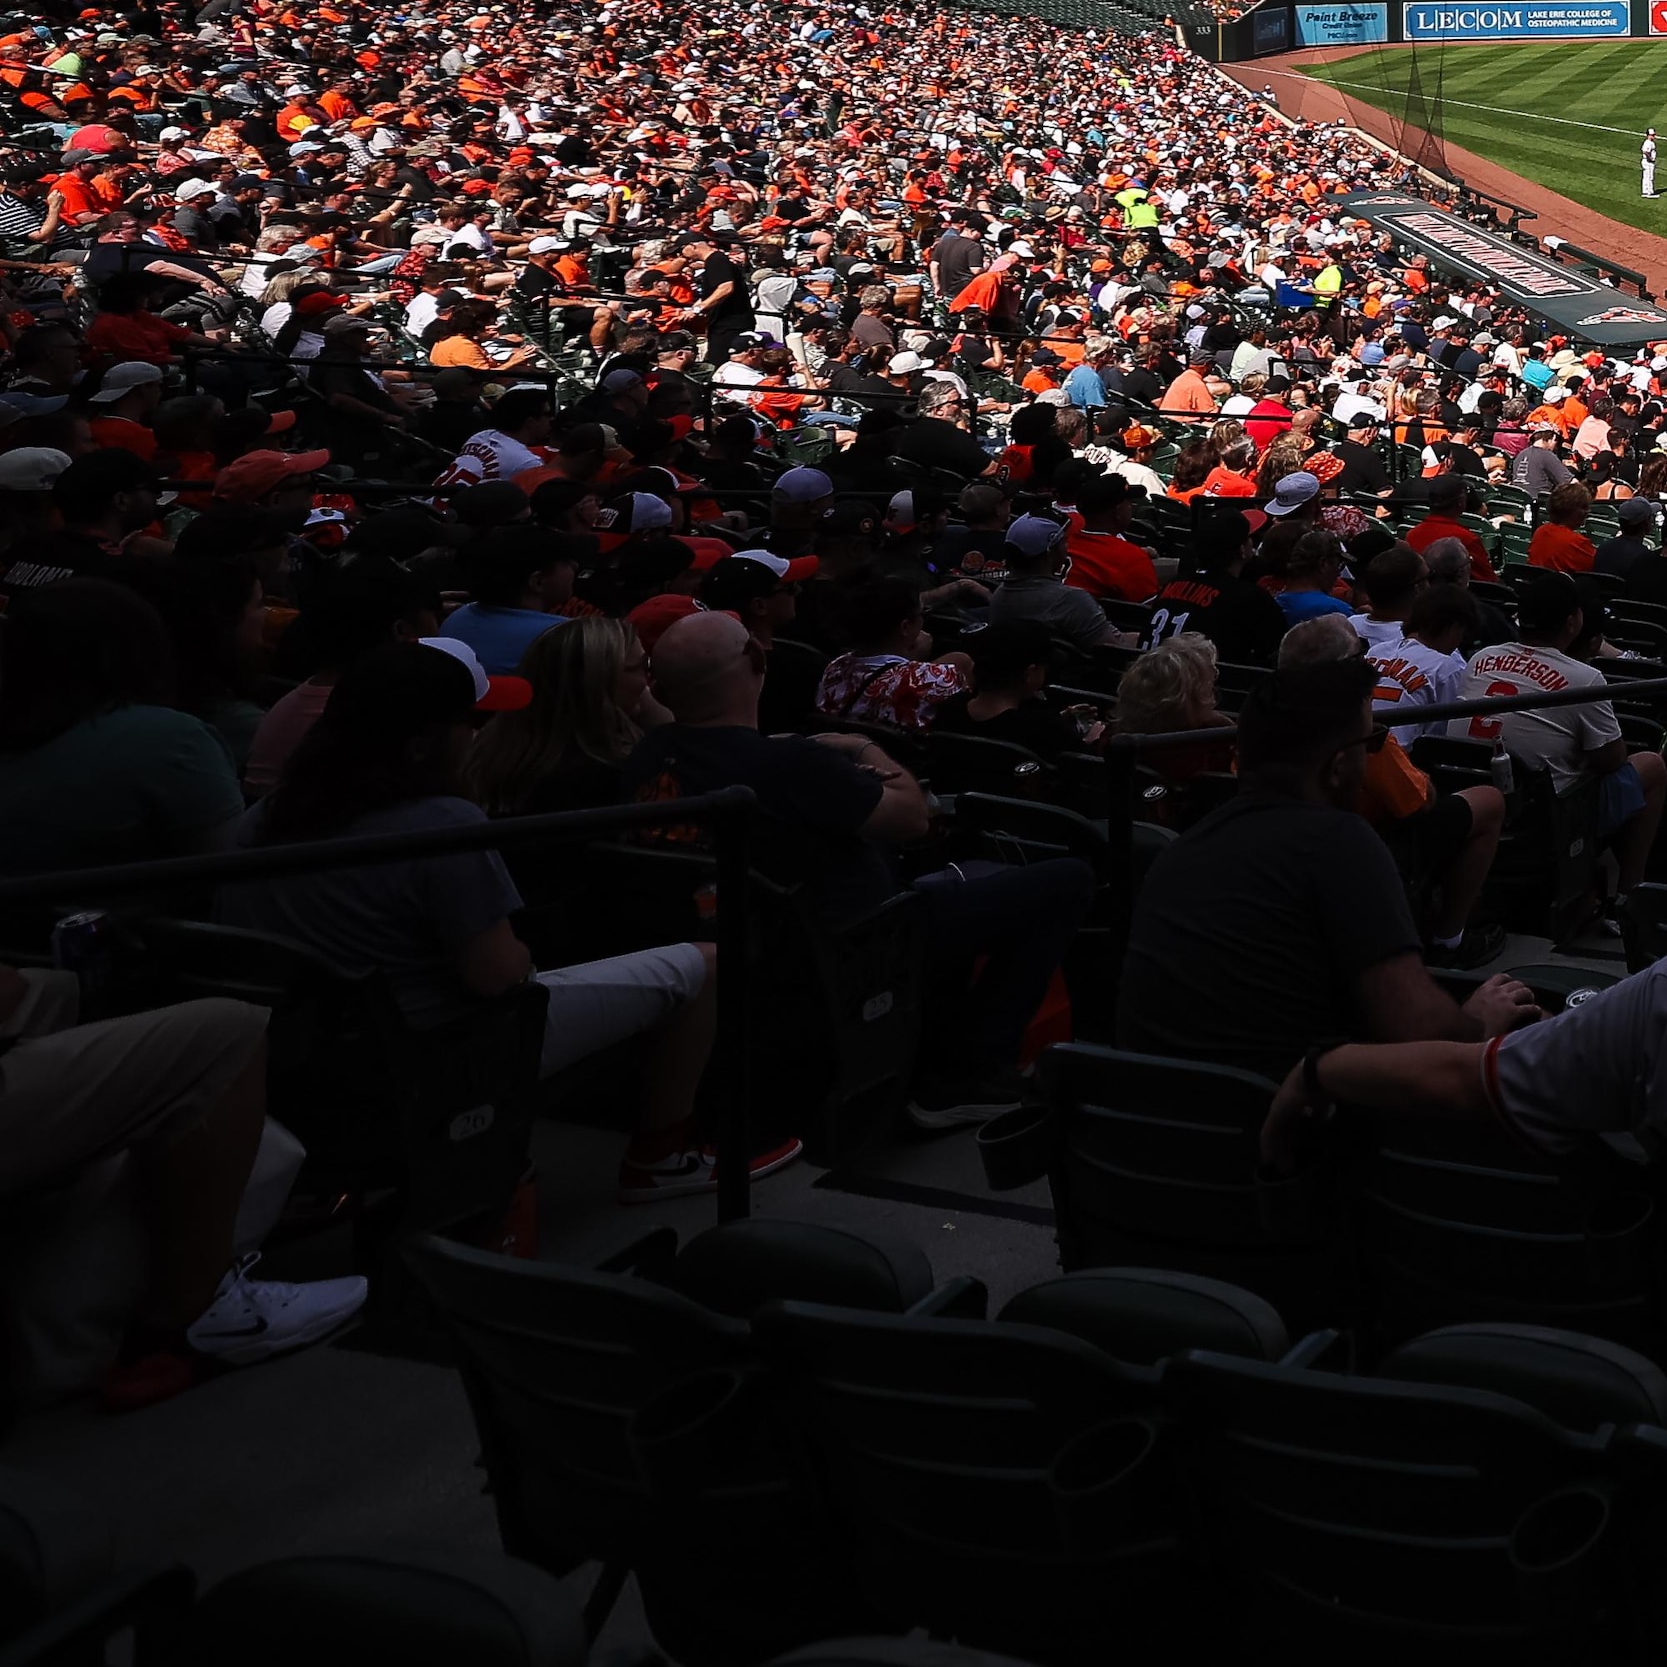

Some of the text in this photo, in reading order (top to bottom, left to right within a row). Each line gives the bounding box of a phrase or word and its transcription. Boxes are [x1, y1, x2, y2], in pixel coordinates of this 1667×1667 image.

[1339, 11, 1378, 22] Breeze
[1527, 11, 1546, 20] LAKE
[1547, 10, 1564, 19] ERIE
[1565, 10, 1599, 19] COLLEGE
[1601, 9, 1612, 18] OF
[1527, 18, 1618, 28] OSTEOPATHIC MEDICINE
[1139, 608, 1188, 647] 31
[1474, 655, 1569, 693] HENDERSON
